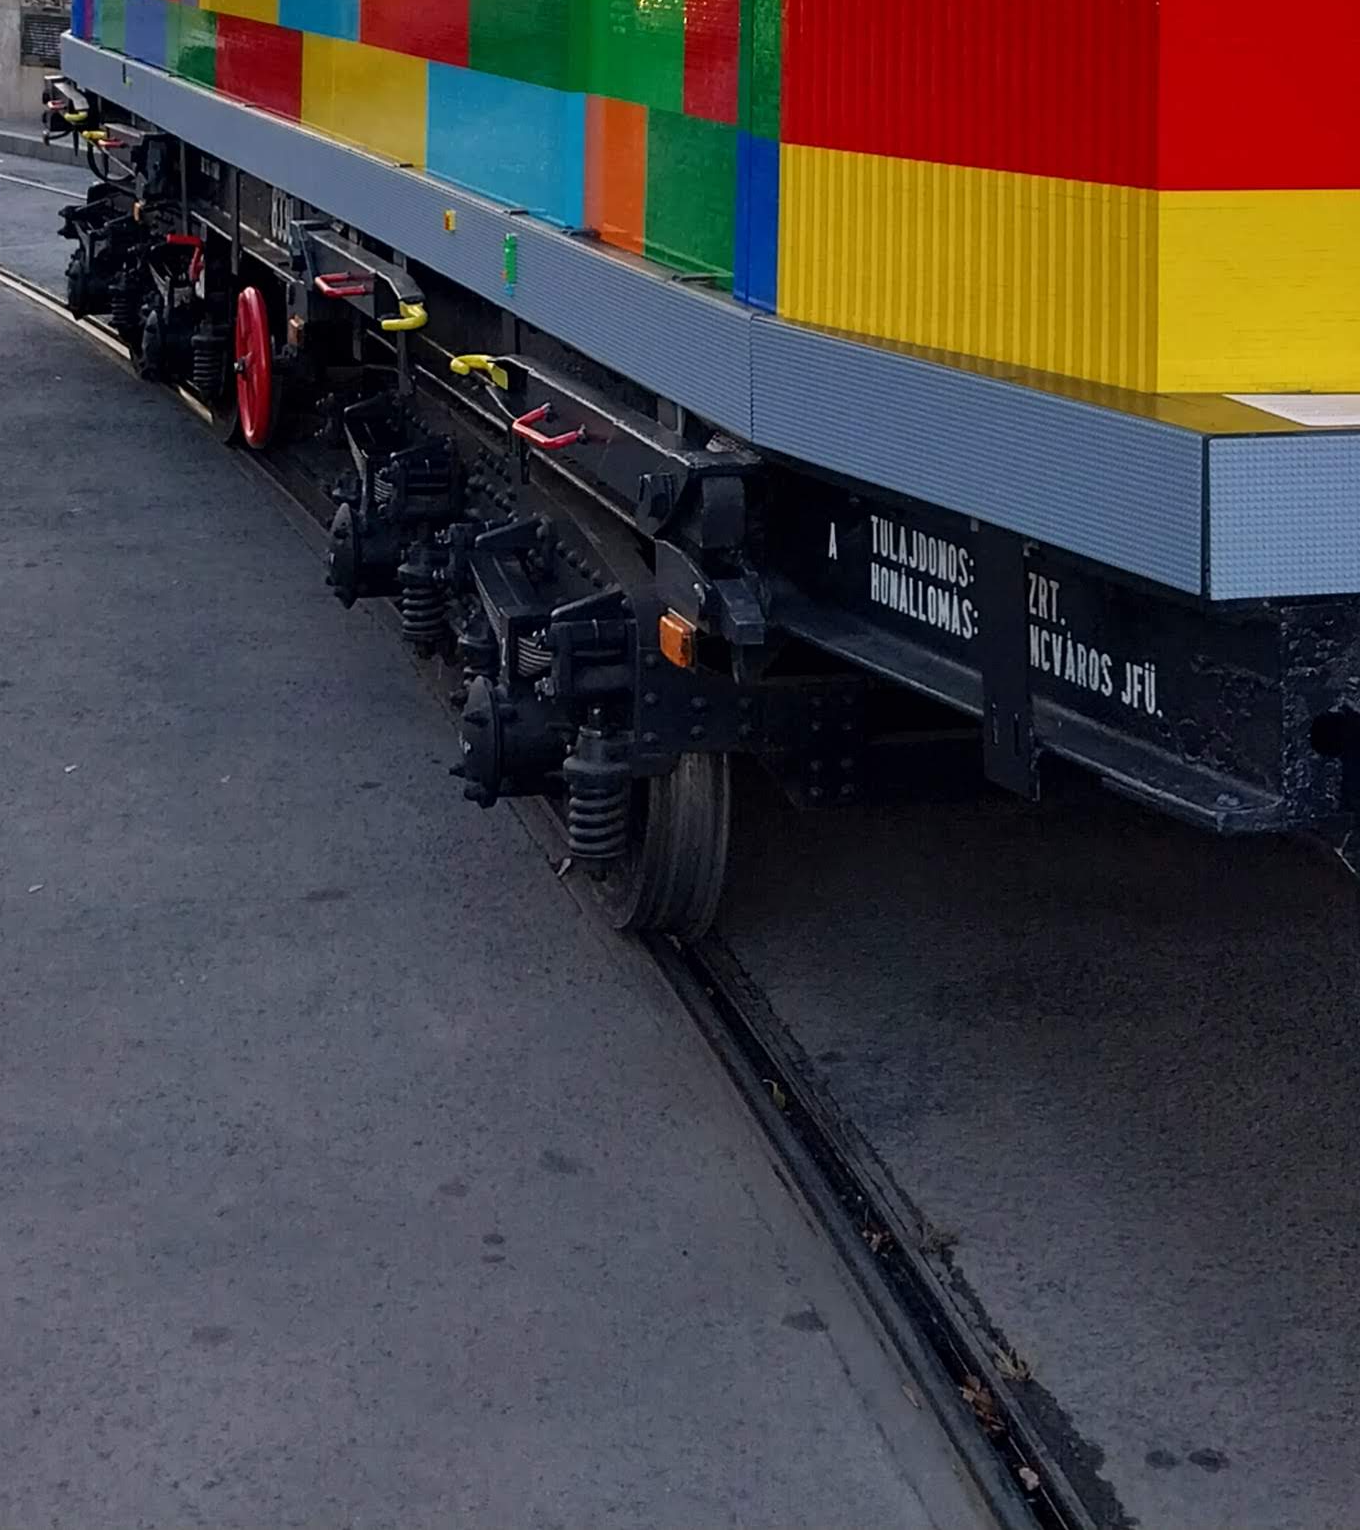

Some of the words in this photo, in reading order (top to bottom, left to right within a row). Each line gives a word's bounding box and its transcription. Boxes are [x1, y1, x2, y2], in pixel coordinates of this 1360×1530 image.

[870, 514, 975, 588] TULAJDONOS:
[870, 561, 979, 640] HONÁLLOMÁS:
[1028, 571, 1066, 626] ZRT.
